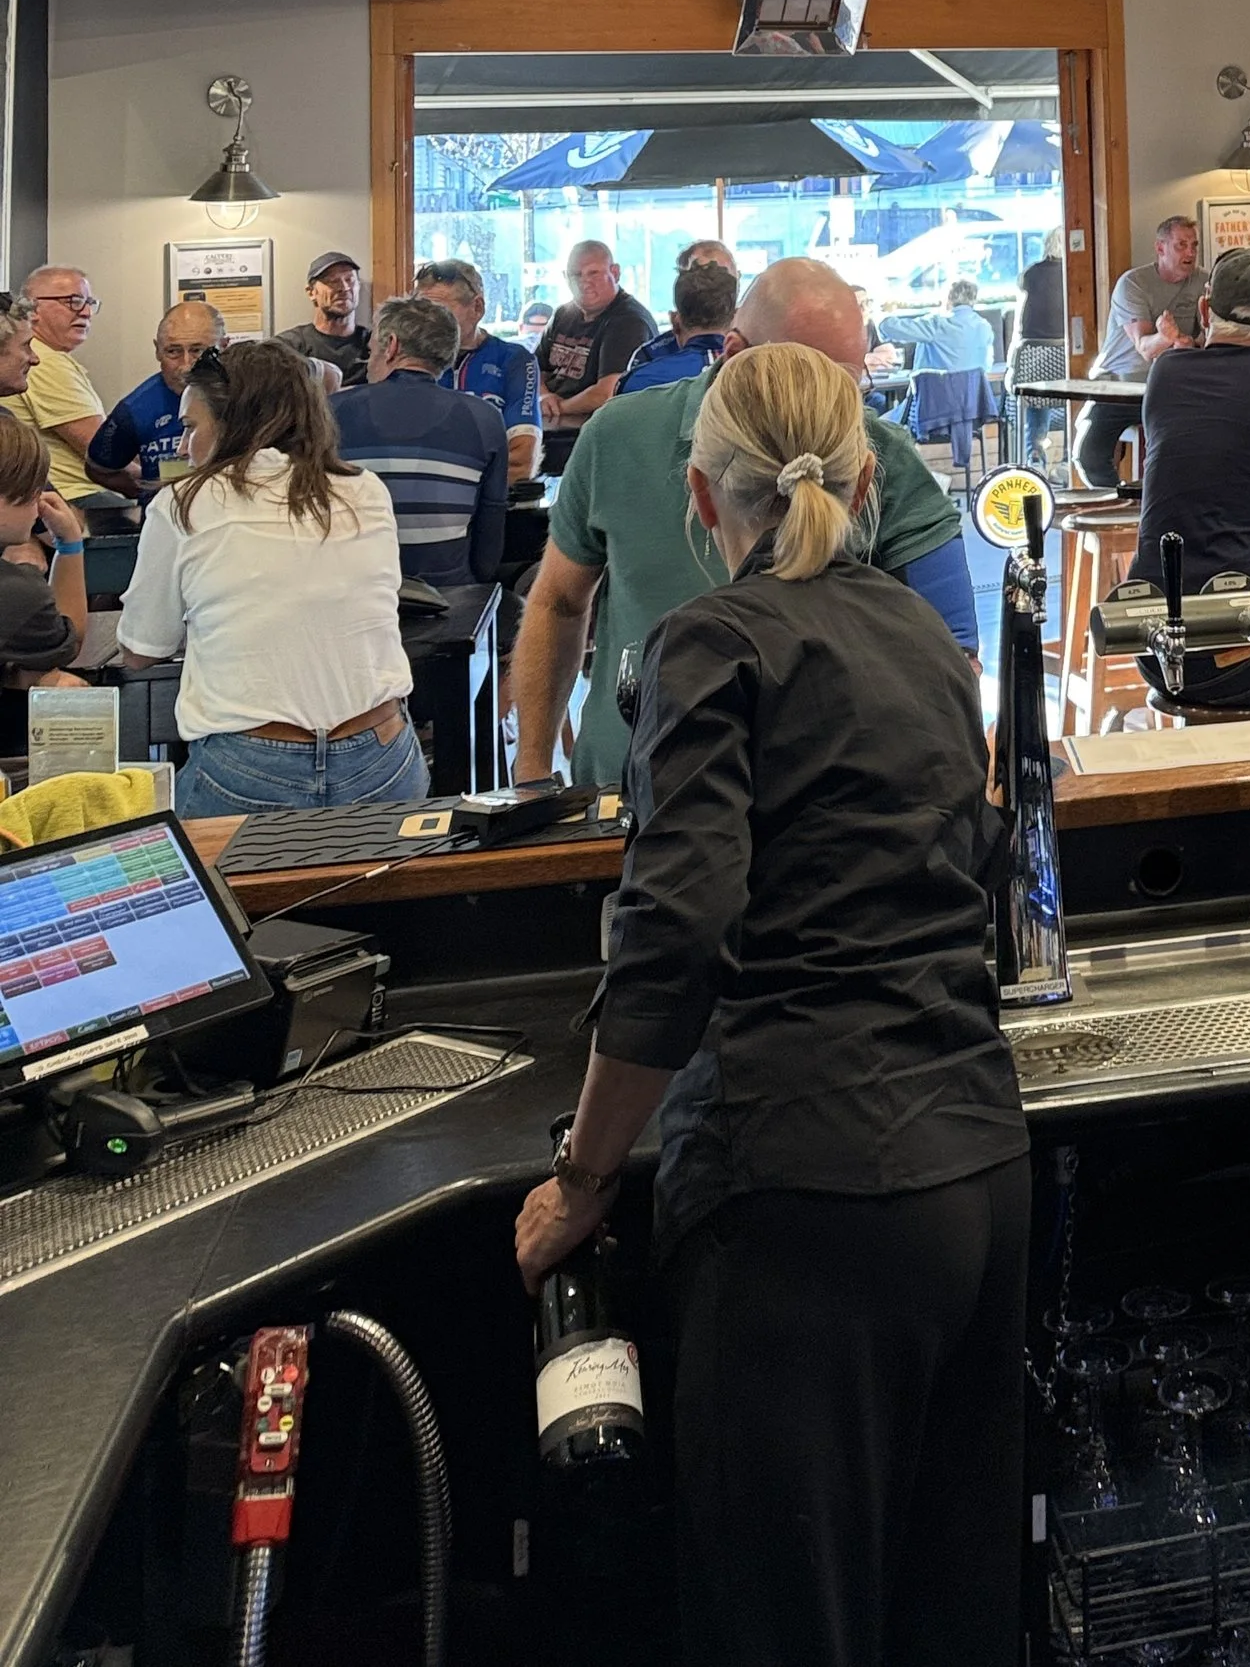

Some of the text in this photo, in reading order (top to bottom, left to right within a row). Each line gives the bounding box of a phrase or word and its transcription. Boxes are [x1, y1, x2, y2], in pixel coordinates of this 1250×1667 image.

[1227, 235, 1245, 246] DAY
[521, 361, 537, 416] PROTOCOL
[991, 478, 1038, 499] PANHEA
[1002, 982, 1065, 996] SUPERCHARGER
